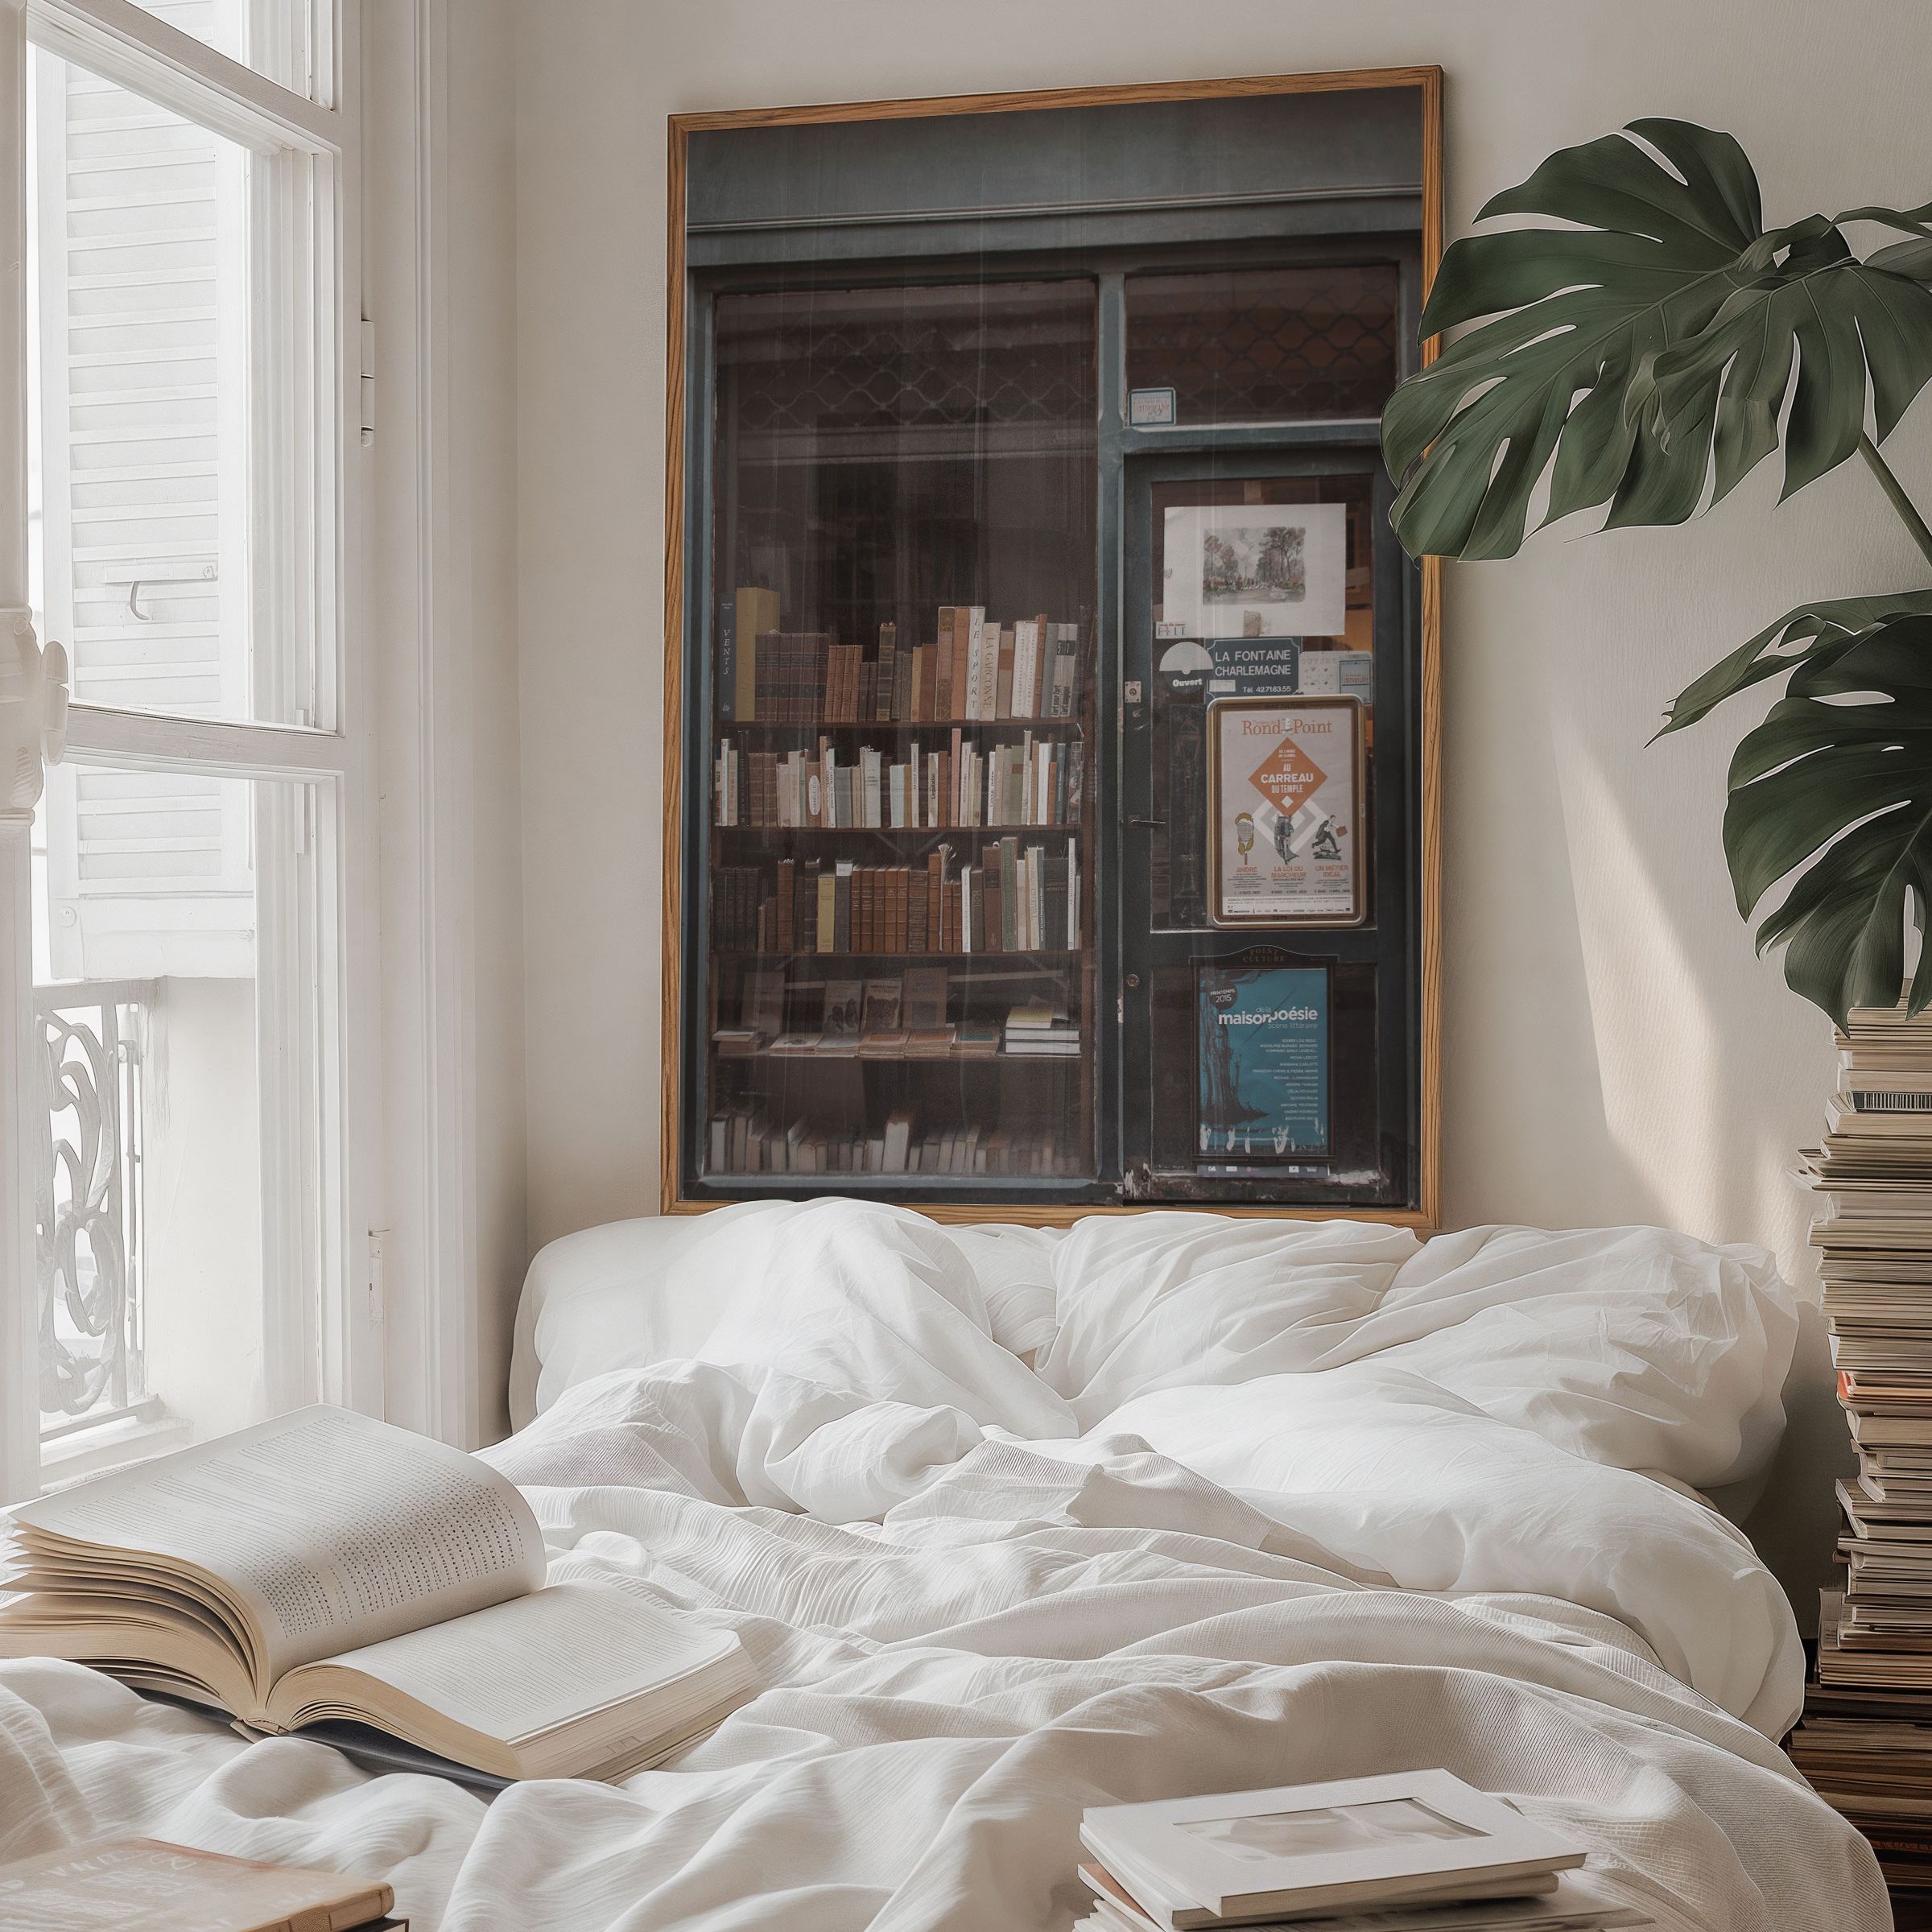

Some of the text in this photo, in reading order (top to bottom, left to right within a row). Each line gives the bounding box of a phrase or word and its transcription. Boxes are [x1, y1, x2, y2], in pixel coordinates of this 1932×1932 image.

[985, 638, 994, 649] LA
[723, 629, 731, 675] VENTS
[1216, 652, 1230, 663] LA
[1235, 650, 1291, 661] FONTAINE
[1215, 665, 1291, 677] CHARLEMAGNE
[971, 649, 979, 708] SPORT
[1173, 678, 1203, 687] Ouvert
[1242, 718, 1333, 736] Rond Point
[1283, 764, 1291, 772] AU
[1261, 774, 1314, 783] CARREAU
[1281, 784, 1303, 793] TEMPLE
[1216, 994, 1232, 1003] 2015
[1218, 1011, 1271, 1025] maison
